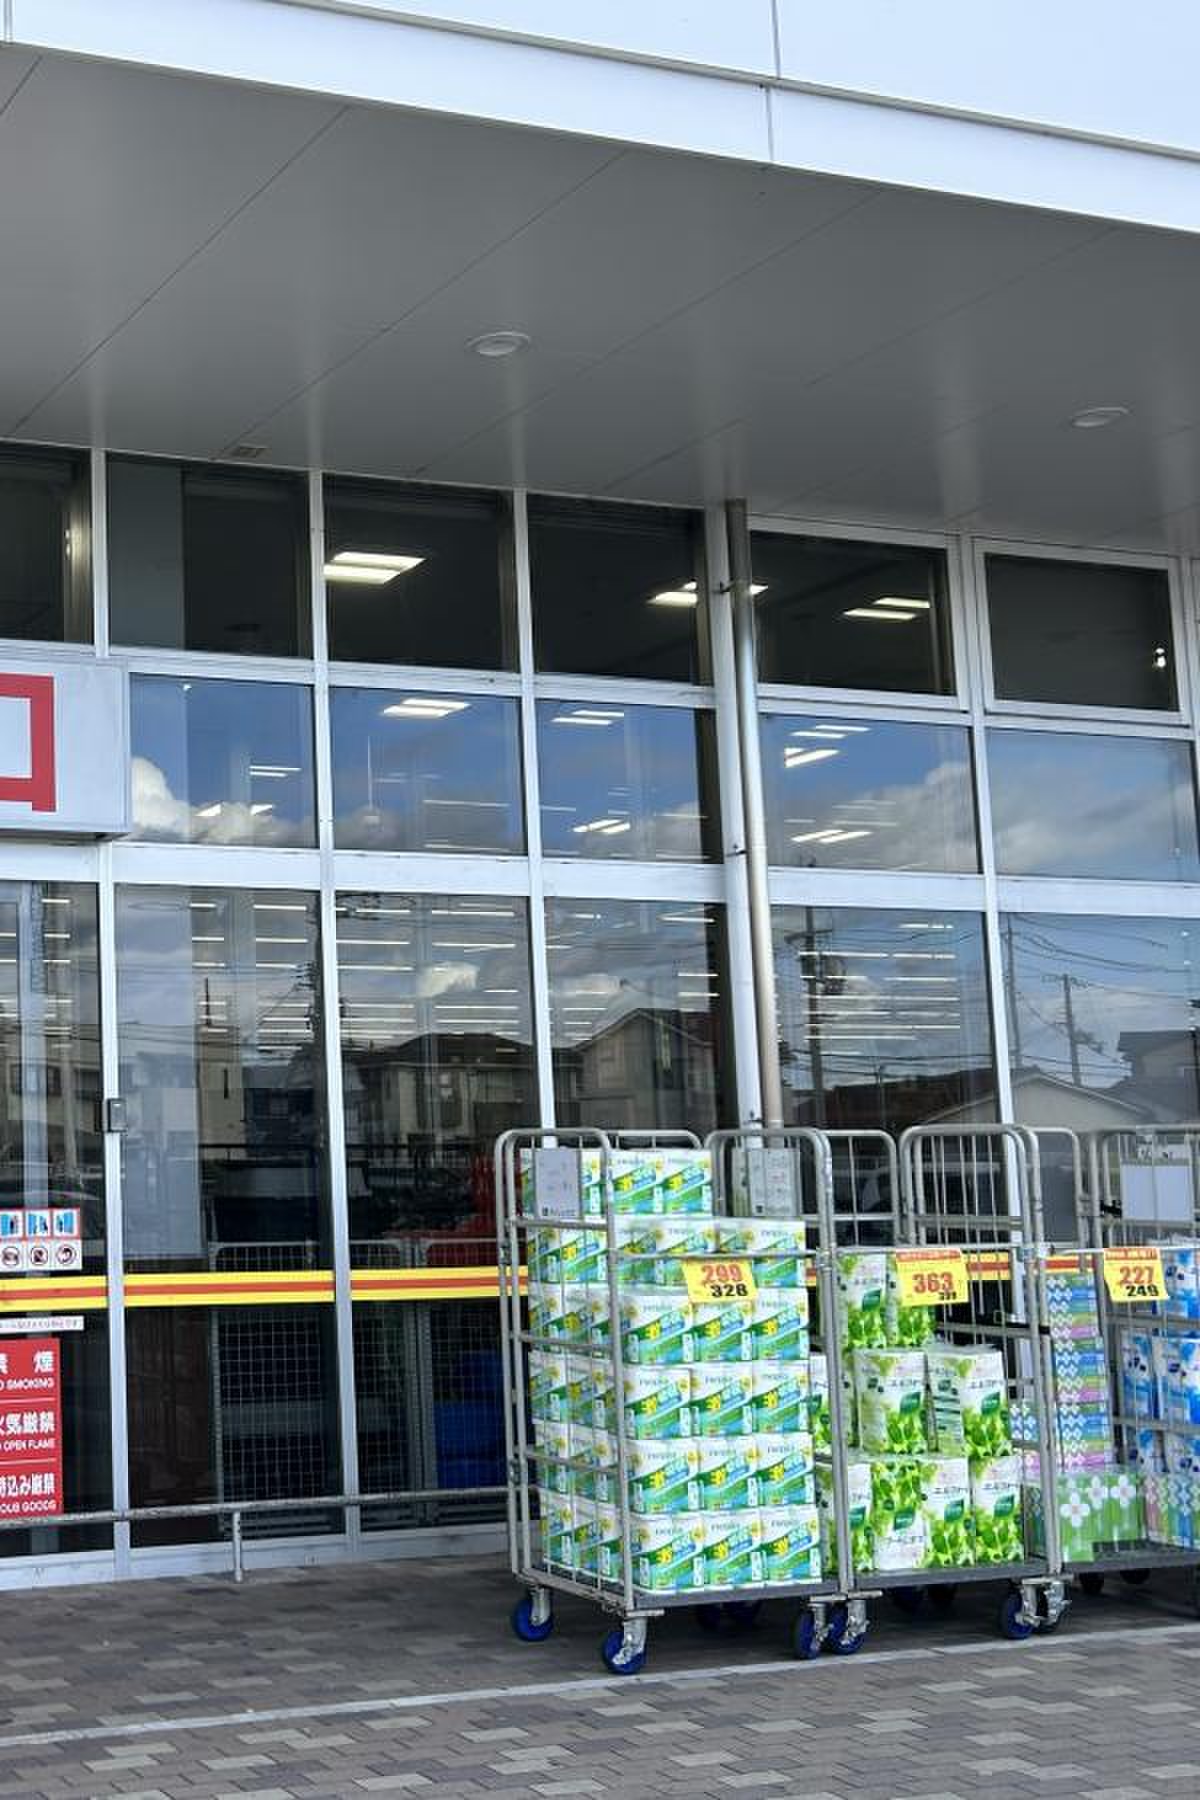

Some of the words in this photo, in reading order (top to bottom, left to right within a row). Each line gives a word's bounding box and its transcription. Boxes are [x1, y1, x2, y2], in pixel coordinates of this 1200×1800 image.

[1119, 1266, 1154, 1284] 227
[912, 1272, 954, 1293] 363
[710, 1283, 748, 1297] 328
[1126, 1284, 1159, 1297] 249
[7, 1377, 54, 1390] SMOKING
[3, 1440, 27, 1451] OPEN
[28, 1438, 55, 1449] FLAME
[22, 1500, 56, 1512] GOODS
